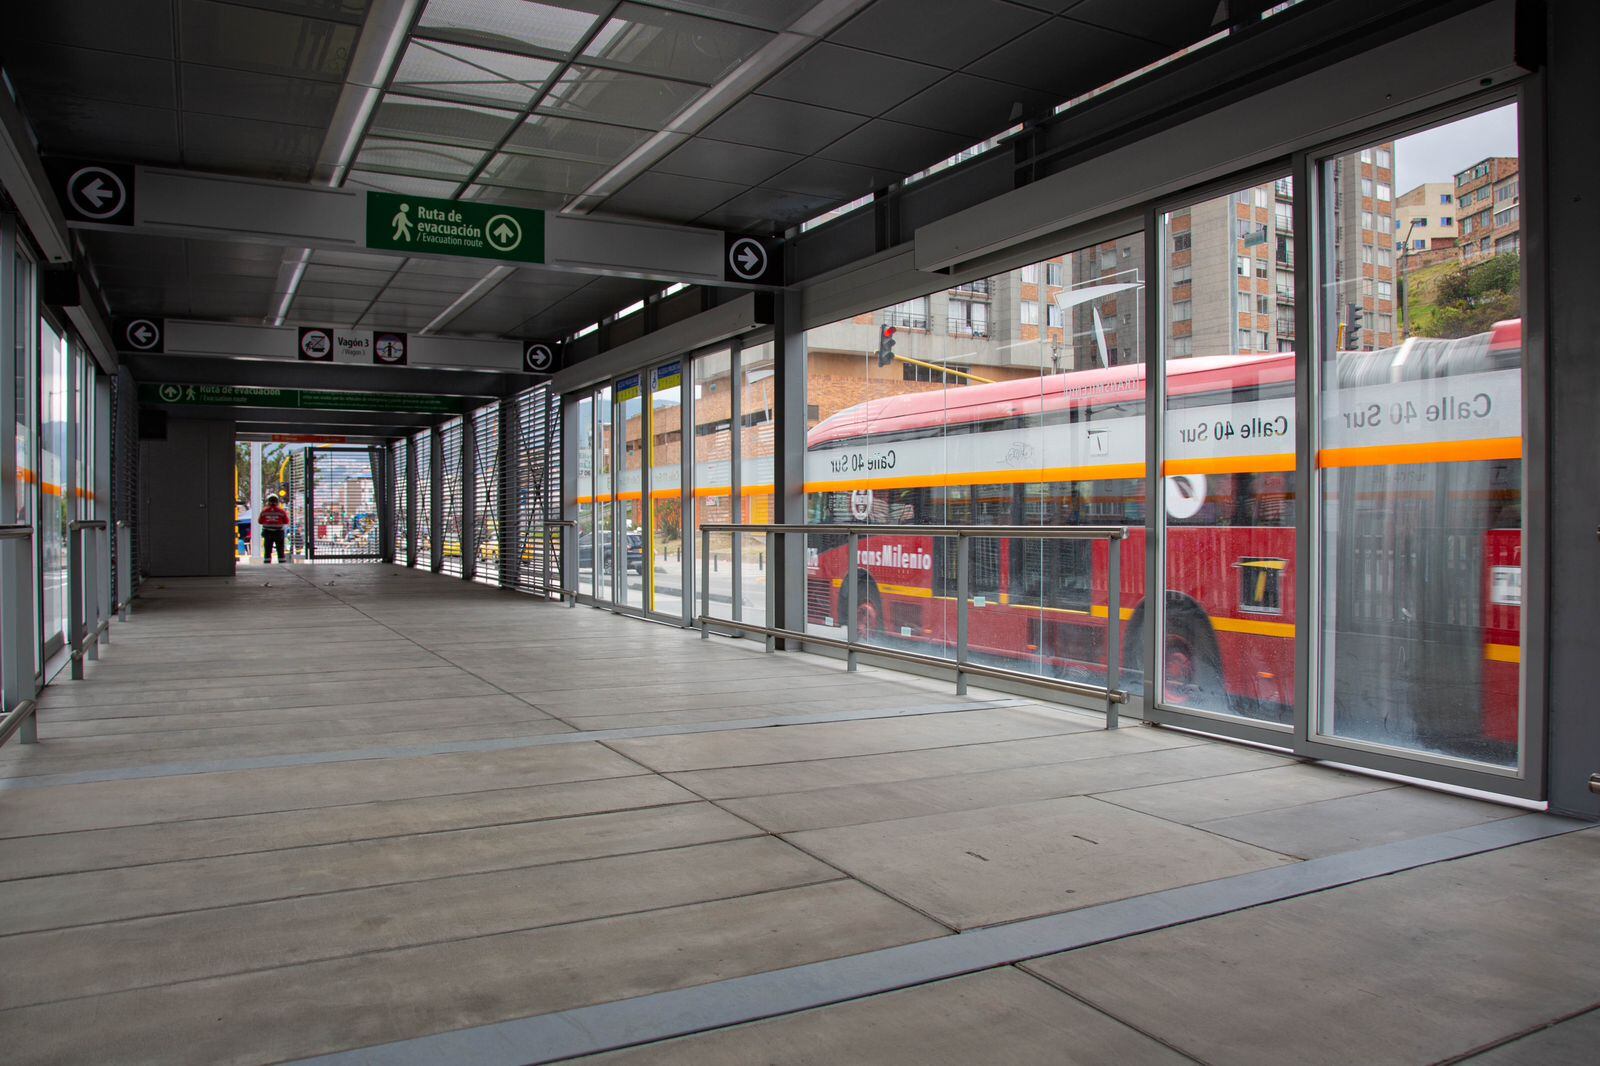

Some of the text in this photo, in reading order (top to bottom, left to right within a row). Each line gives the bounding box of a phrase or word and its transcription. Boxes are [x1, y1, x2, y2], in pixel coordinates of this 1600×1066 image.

[418, 206, 462, 223] Ruta de
[417, 222, 481, 238] evacuación
[422, 232, 463, 246] Evacuation
[463, 239, 483, 248] route
[337, 336, 370, 349] Vagón 3
[857, 544, 932, 570] ransMilenio
